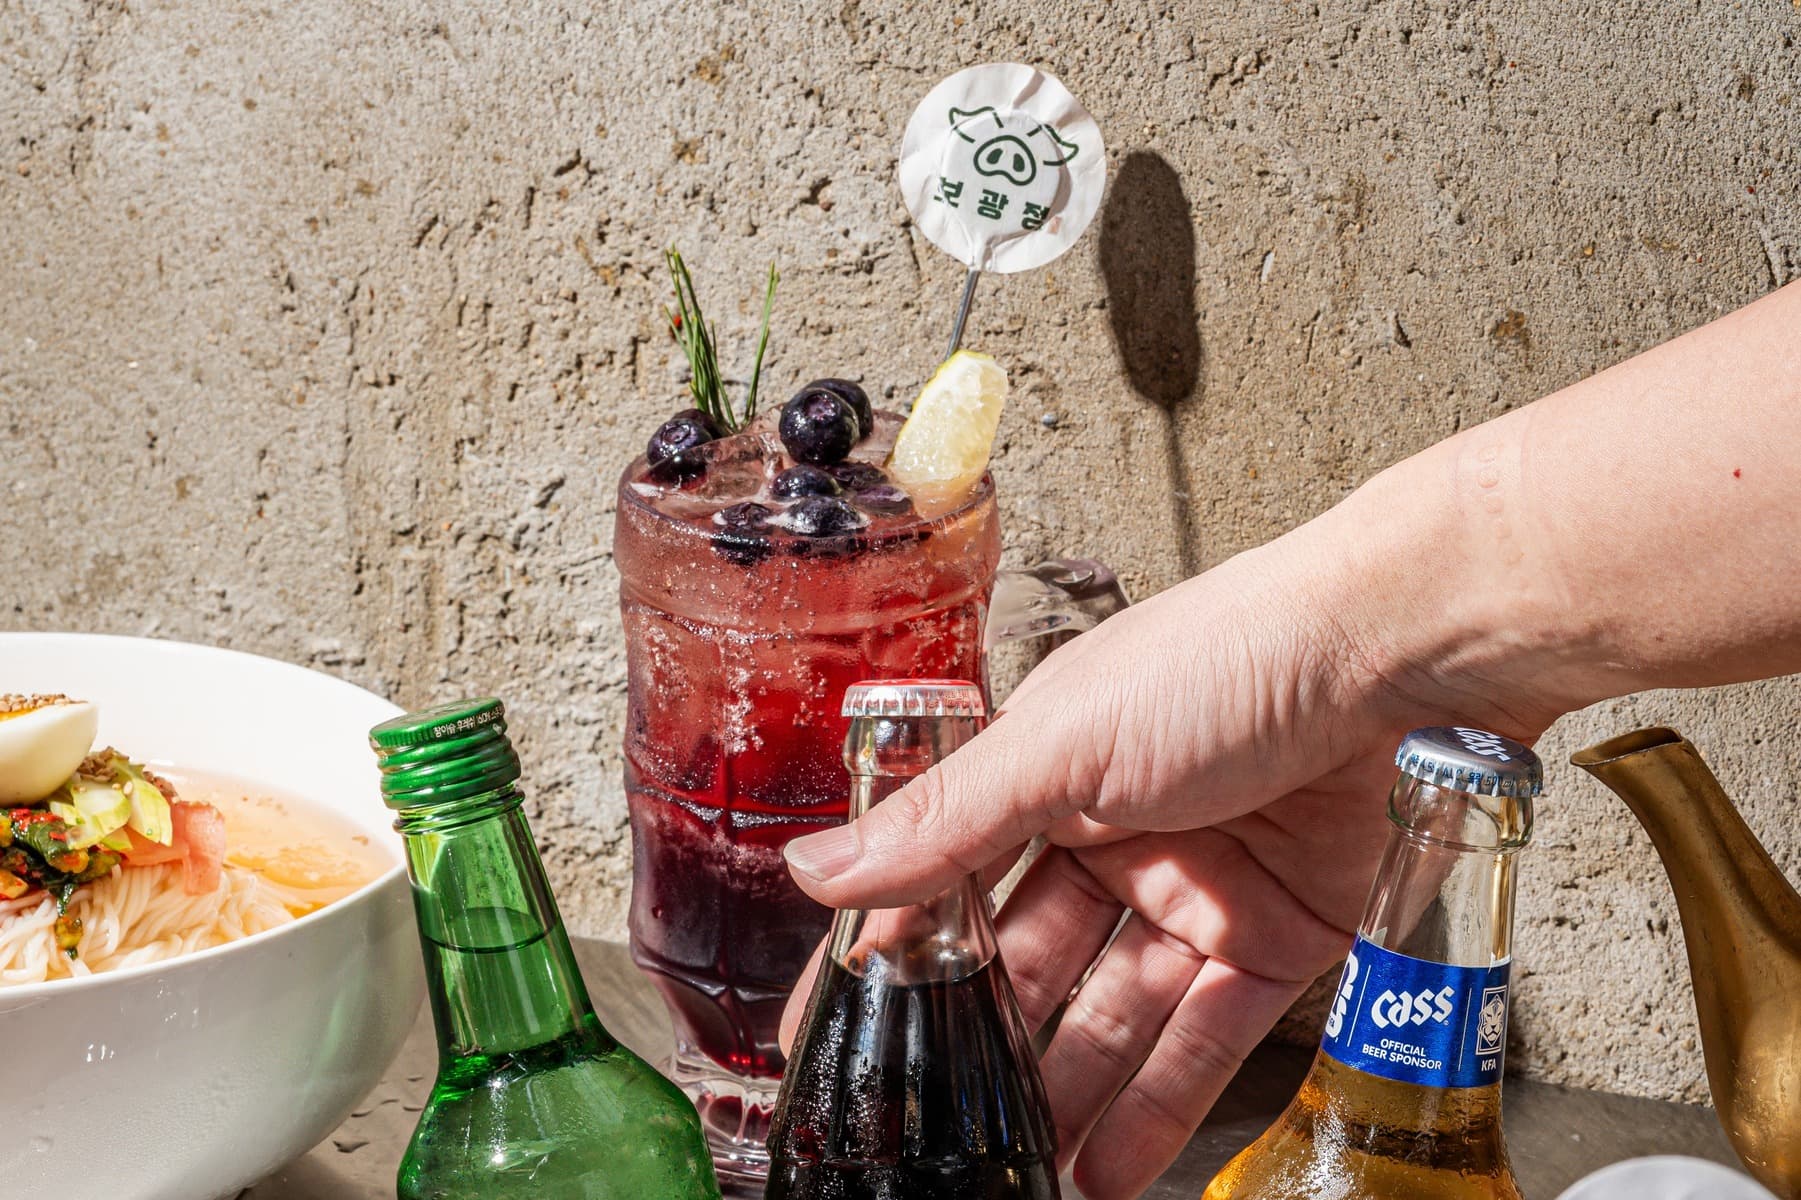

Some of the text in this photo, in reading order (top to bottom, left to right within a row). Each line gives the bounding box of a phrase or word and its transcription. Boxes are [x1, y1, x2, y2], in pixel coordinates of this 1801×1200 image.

[1362, 1043, 1442, 1071] BEER SPONSOR
[1380, 1038, 1427, 1057] OFFICIAL
[1481, 1058, 1497, 1072] KFA
